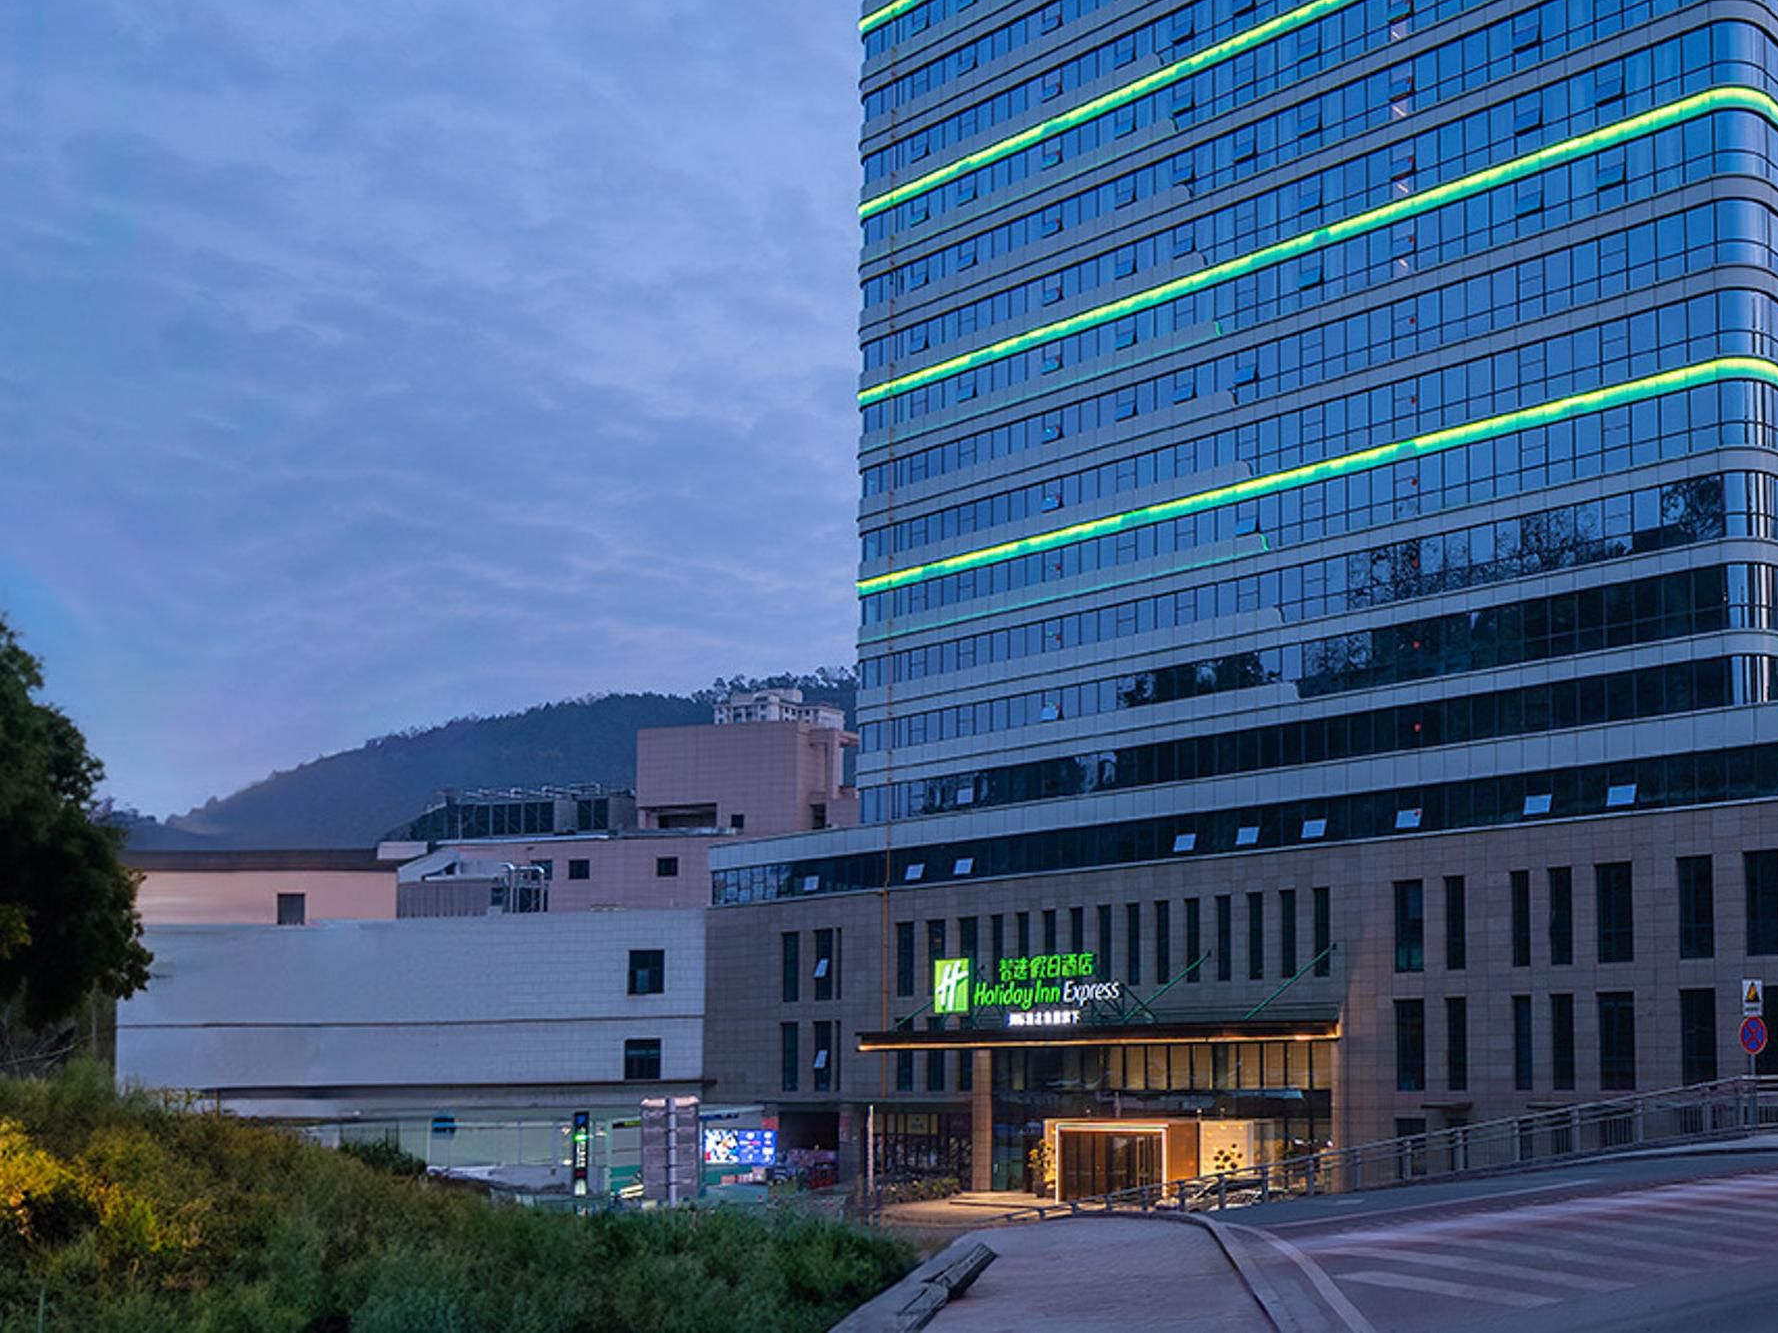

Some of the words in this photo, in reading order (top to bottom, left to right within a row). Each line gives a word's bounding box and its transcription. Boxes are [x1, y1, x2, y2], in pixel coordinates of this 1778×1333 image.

[974, 980, 1034, 1010] Holiday
[1034, 979, 1061, 1004] Inn
[1063, 980, 1119, 1007] Express
